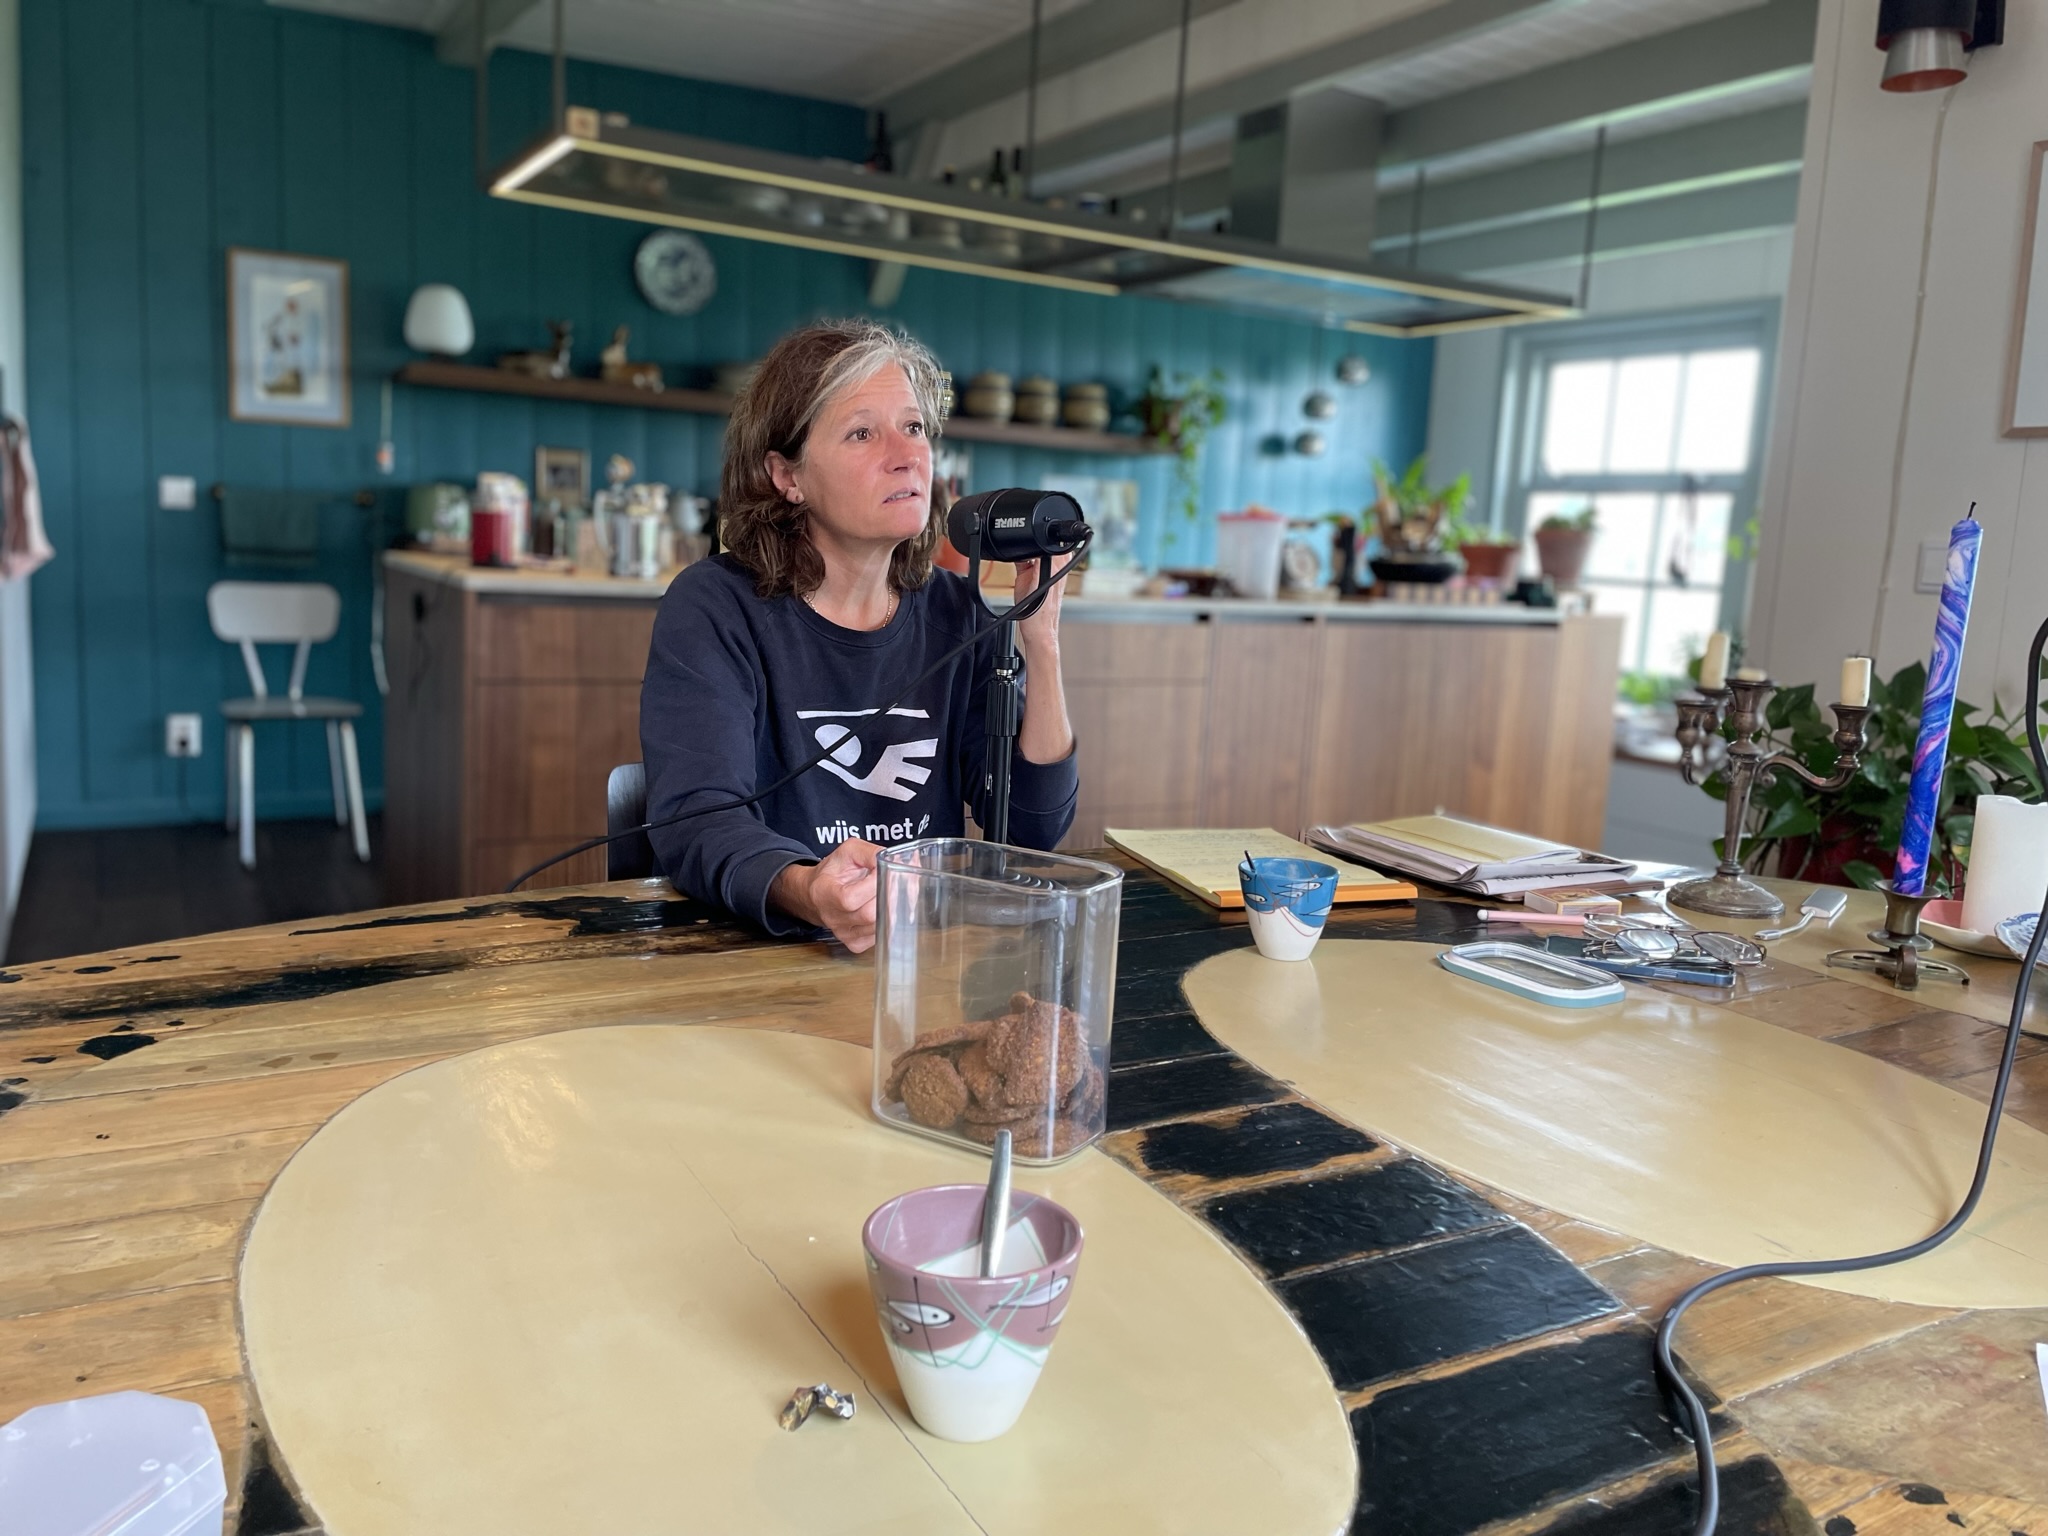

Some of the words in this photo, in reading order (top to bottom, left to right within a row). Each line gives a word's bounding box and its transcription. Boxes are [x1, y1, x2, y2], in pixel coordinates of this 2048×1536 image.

[995, 517, 1026, 529] SHURE
[815, 820, 861, 844] wijs
[865, 817, 914, 841] met
